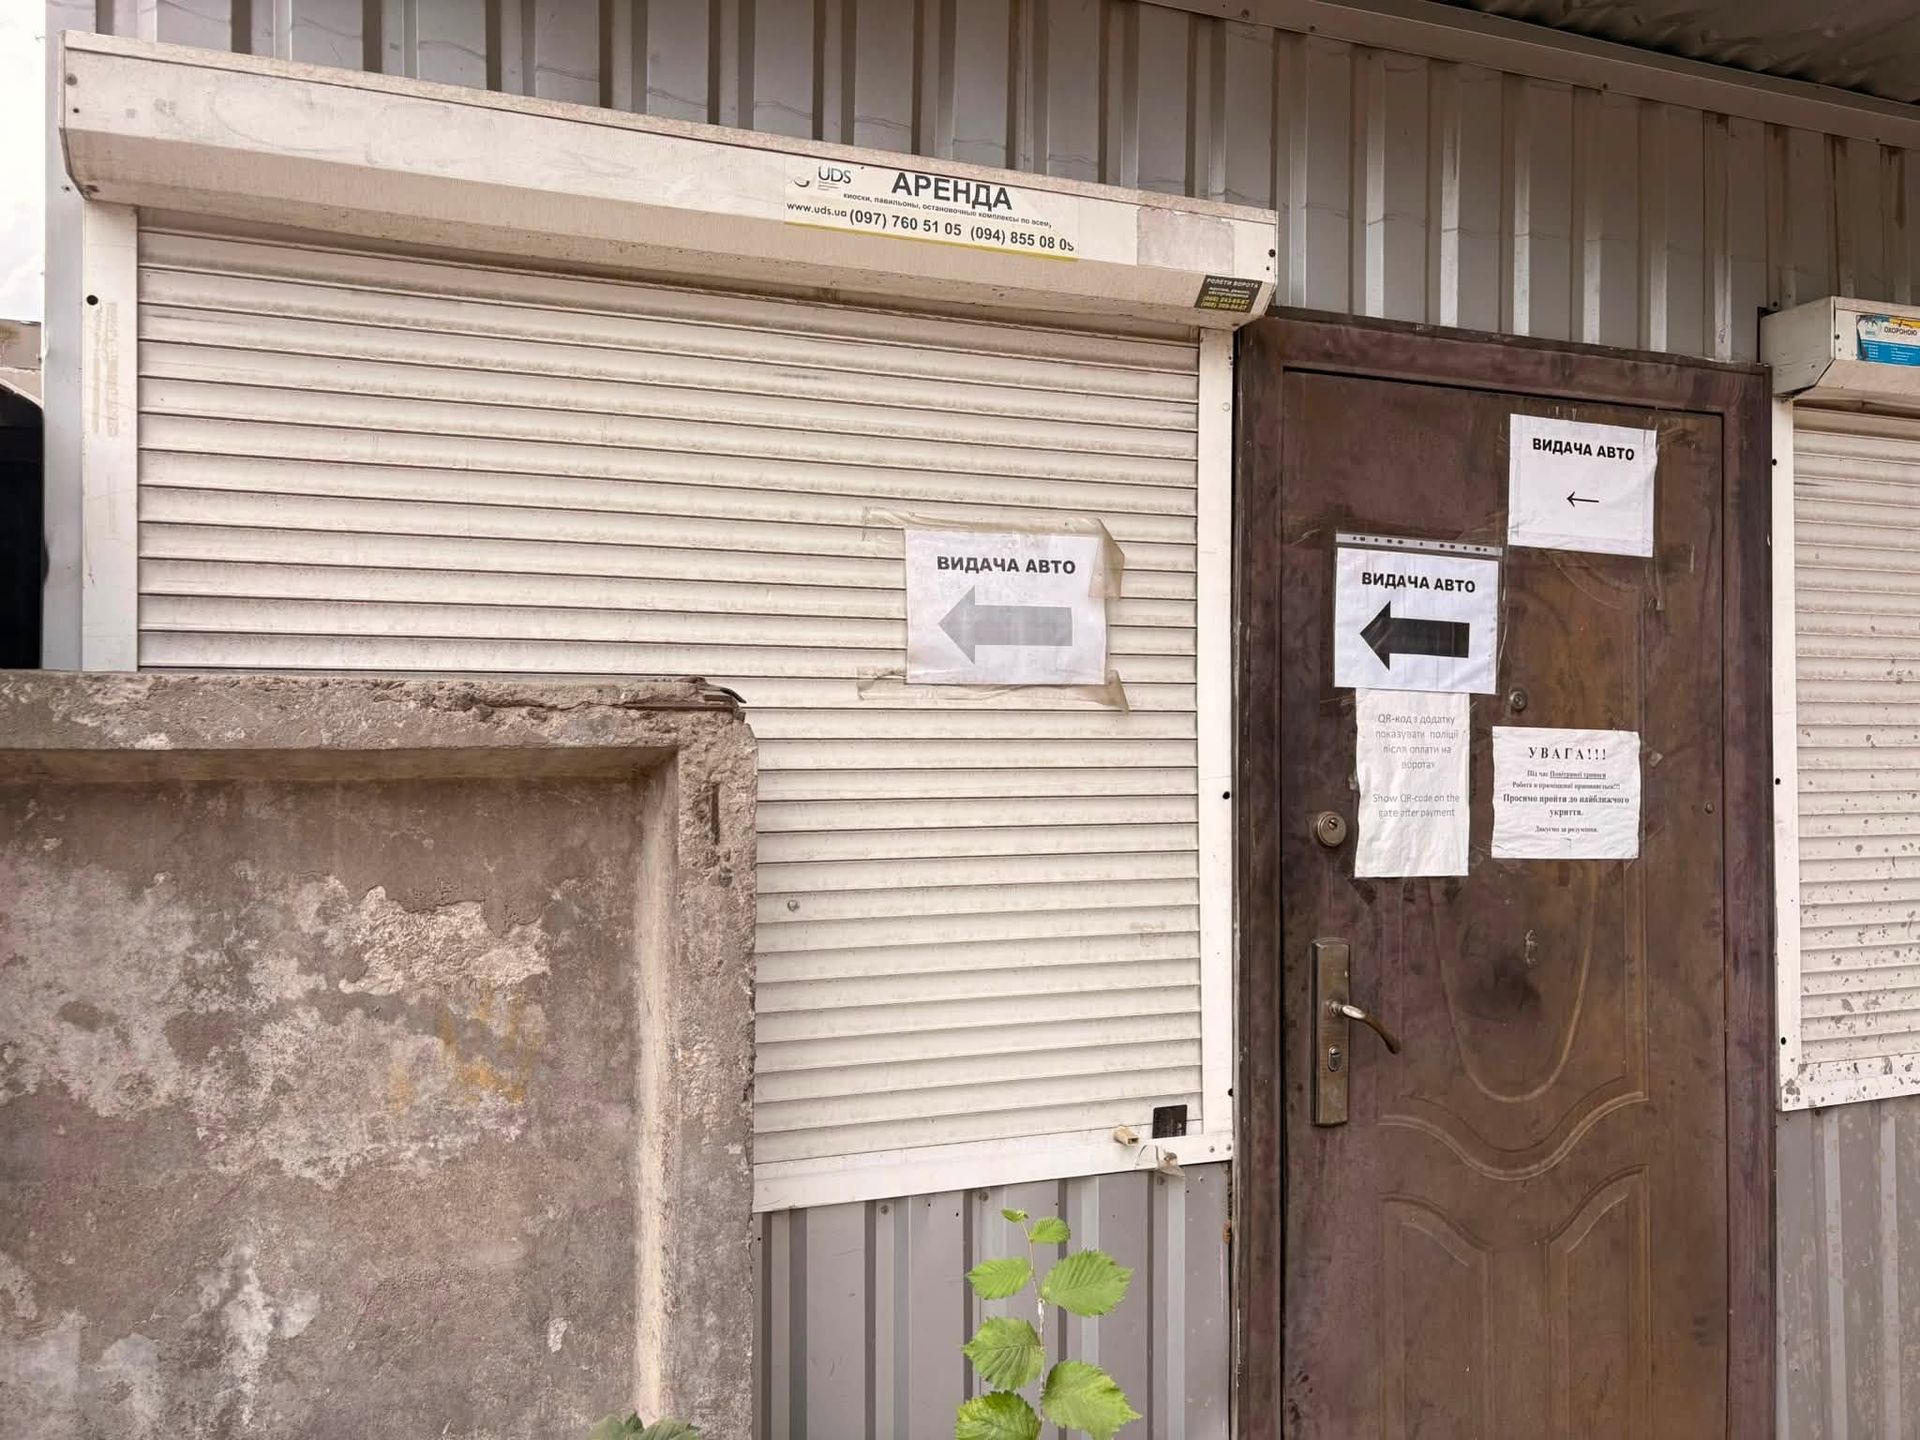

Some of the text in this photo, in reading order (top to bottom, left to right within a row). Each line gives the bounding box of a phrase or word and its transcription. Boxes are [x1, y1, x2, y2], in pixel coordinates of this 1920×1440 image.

[818, 165, 852, 184] UDS
[891, 172, 1013, 212] АРЕНДА
[843, 193, 873, 203] киоски,
[874, 197, 921, 210] павильоны,
[978, 212, 1019, 223] комплексы
[786, 202, 847, 218] www.uds.ua
[850, 209, 887, 229] (097)
[892, 215, 918, 231] 760
[923, 220, 939, 233] 51
[944, 222, 962, 236] 05
[970, 225, 1006, 245] (094)
[1010, 231, 1035, 247] 855
[1039, 235, 1055, 249] 08
[1532, 437, 1635, 461] ВИДАЧА АВТО
[937, 556, 1076, 574] ВИДАЧА АВТО
[1361, 572, 1476, 593] ВИДАЧА АВТО
[1377, 713, 1412, 725] QR-код
[1419, 715, 1456, 727] додатку
[1375, 730, 1425, 740] показувати
[1409, 746, 1440, 755] оплати
[1528, 746, 1607, 760] УВАГА!!!
[1372, 793, 1398, 803] Show
[1400, 793, 1434, 803] QR-code
[1446, 794, 1460, 803] the
[1503, 793, 1538, 804] Просимо
[1539, 795, 1567, 805] пройти
[1579, 795, 1630, 804] найближчого
[1378, 809, 1456, 819] gate after payment
[1549, 809, 1583, 818] укриття.
